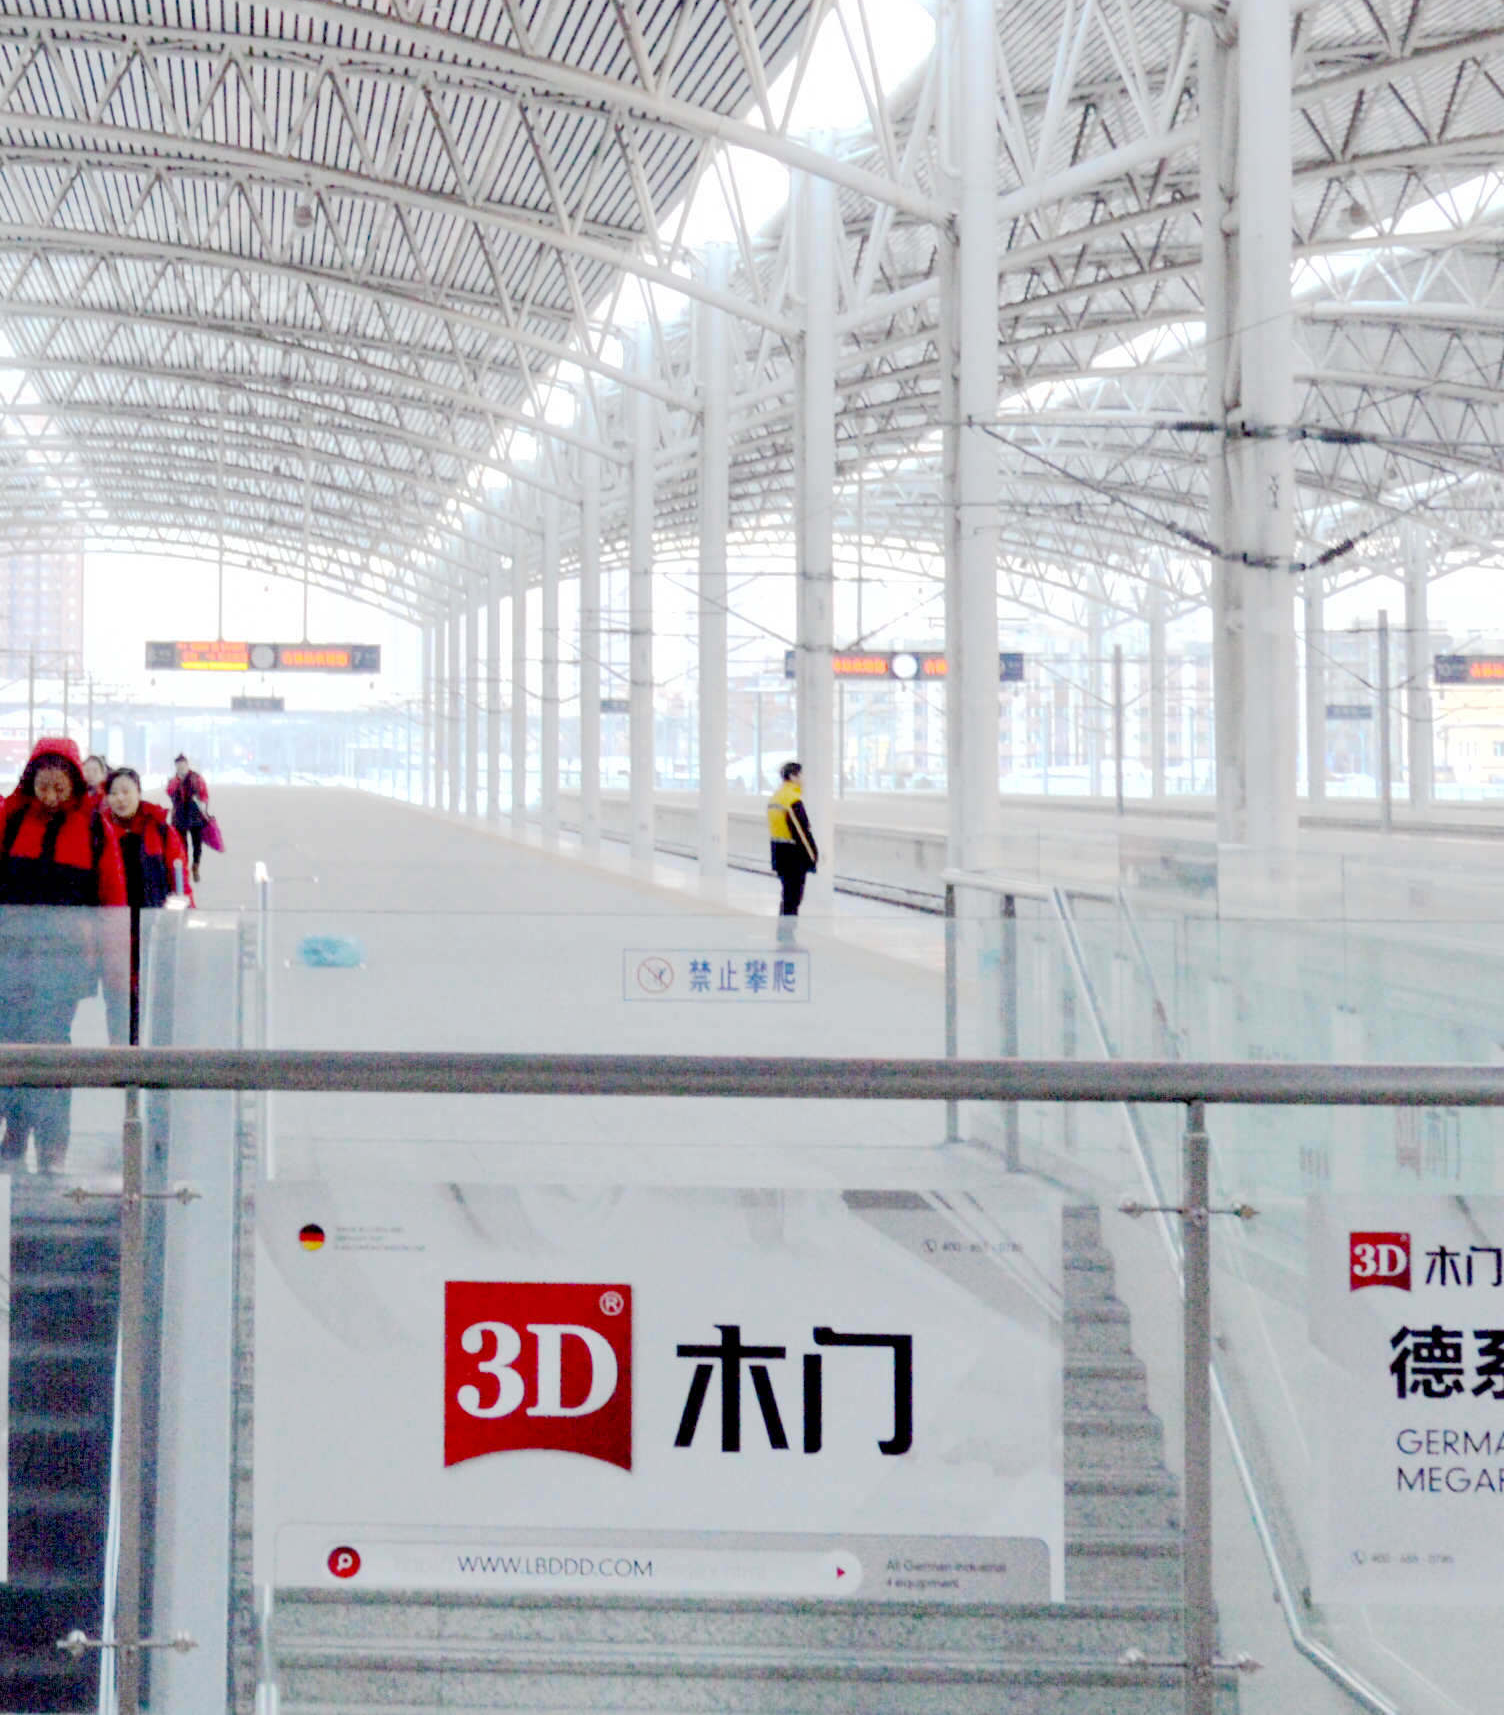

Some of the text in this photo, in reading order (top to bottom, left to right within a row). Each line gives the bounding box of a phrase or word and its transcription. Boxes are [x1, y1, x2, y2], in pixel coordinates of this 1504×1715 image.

[688, 959, 796, 993] 禁止攀爬
[1353, 1242, 1504, 1288] 3D 木门
[456, 1320, 915, 1457] 3D 木门
[456, 1554, 654, 1579] WWW.LBDDD.COM
